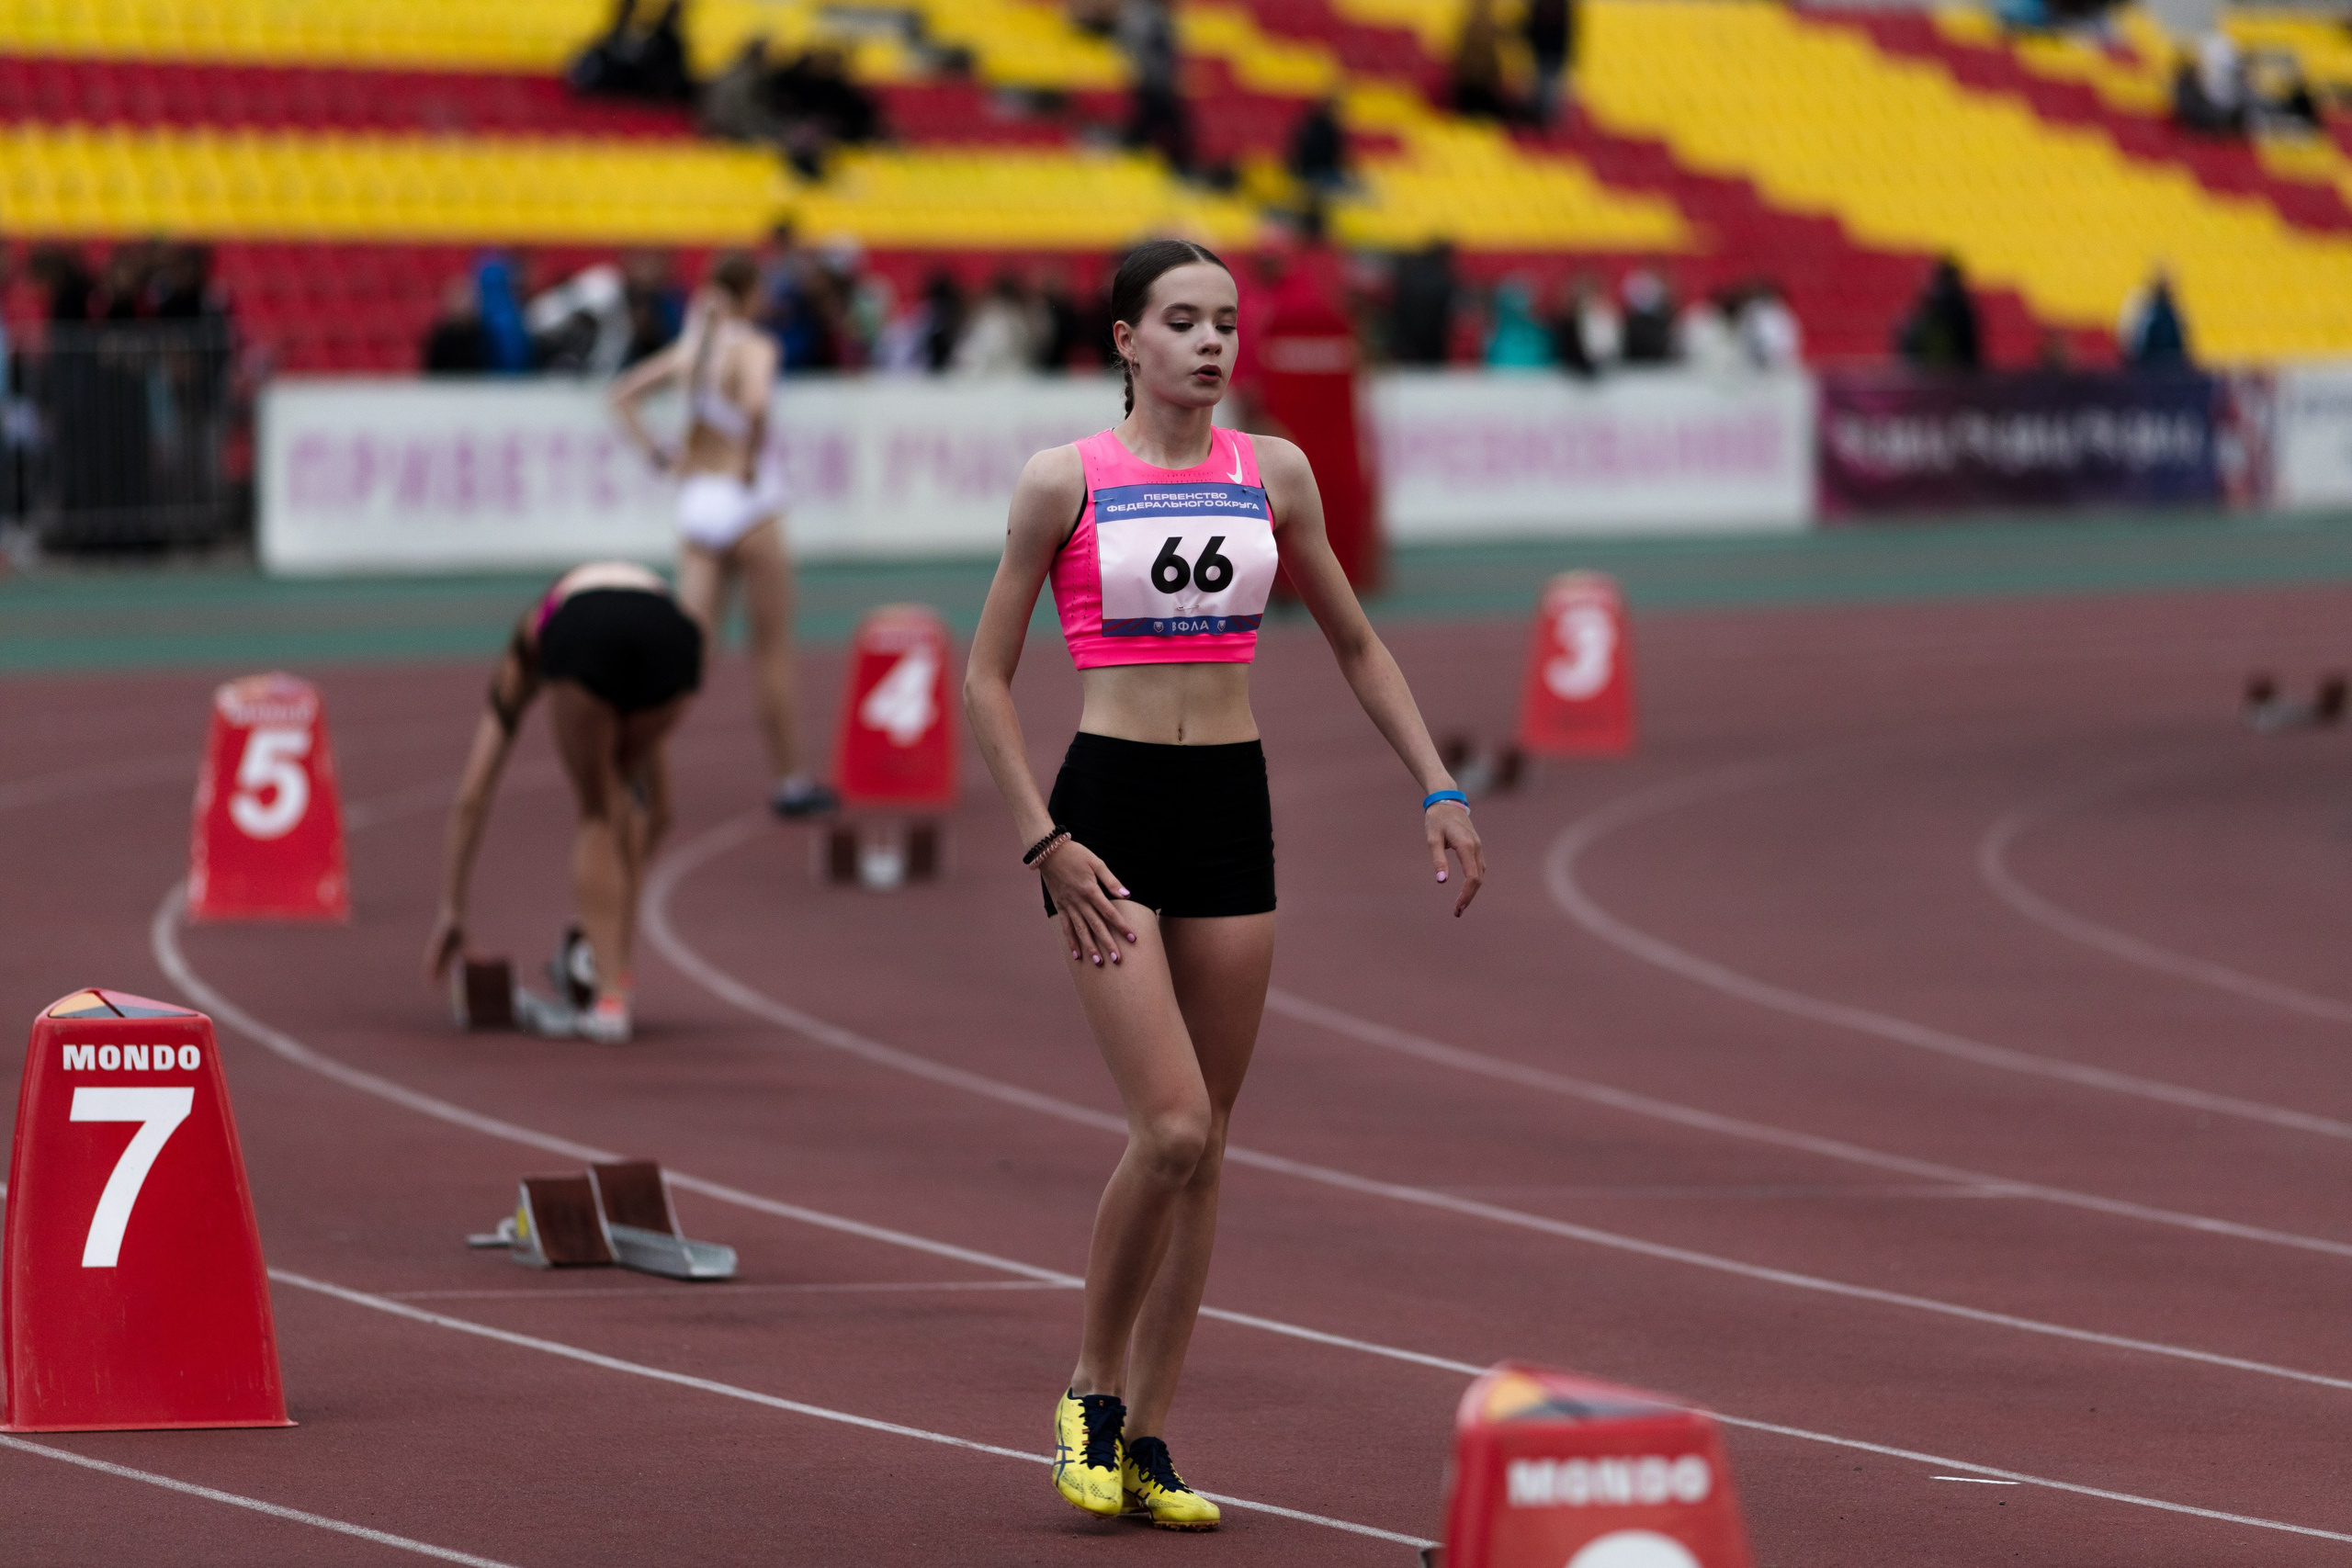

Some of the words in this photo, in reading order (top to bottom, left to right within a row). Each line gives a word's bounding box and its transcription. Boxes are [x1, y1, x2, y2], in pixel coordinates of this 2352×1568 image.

[1106, 500, 1215, 513] ФЕДЕРАЛЬНОГО
[1215, 501, 1260, 511] ОКРУГА
[1143, 492, 1227, 502] ПЕРВЕНСТВО
[1150, 536, 1234, 594] 66
[1544, 607, 1617, 701] 3
[860, 646, 940, 748] 4
[228, 730, 312, 840] 5
[62, 1043, 201, 1071] MONDO
[69, 1086, 195, 1268] 7
